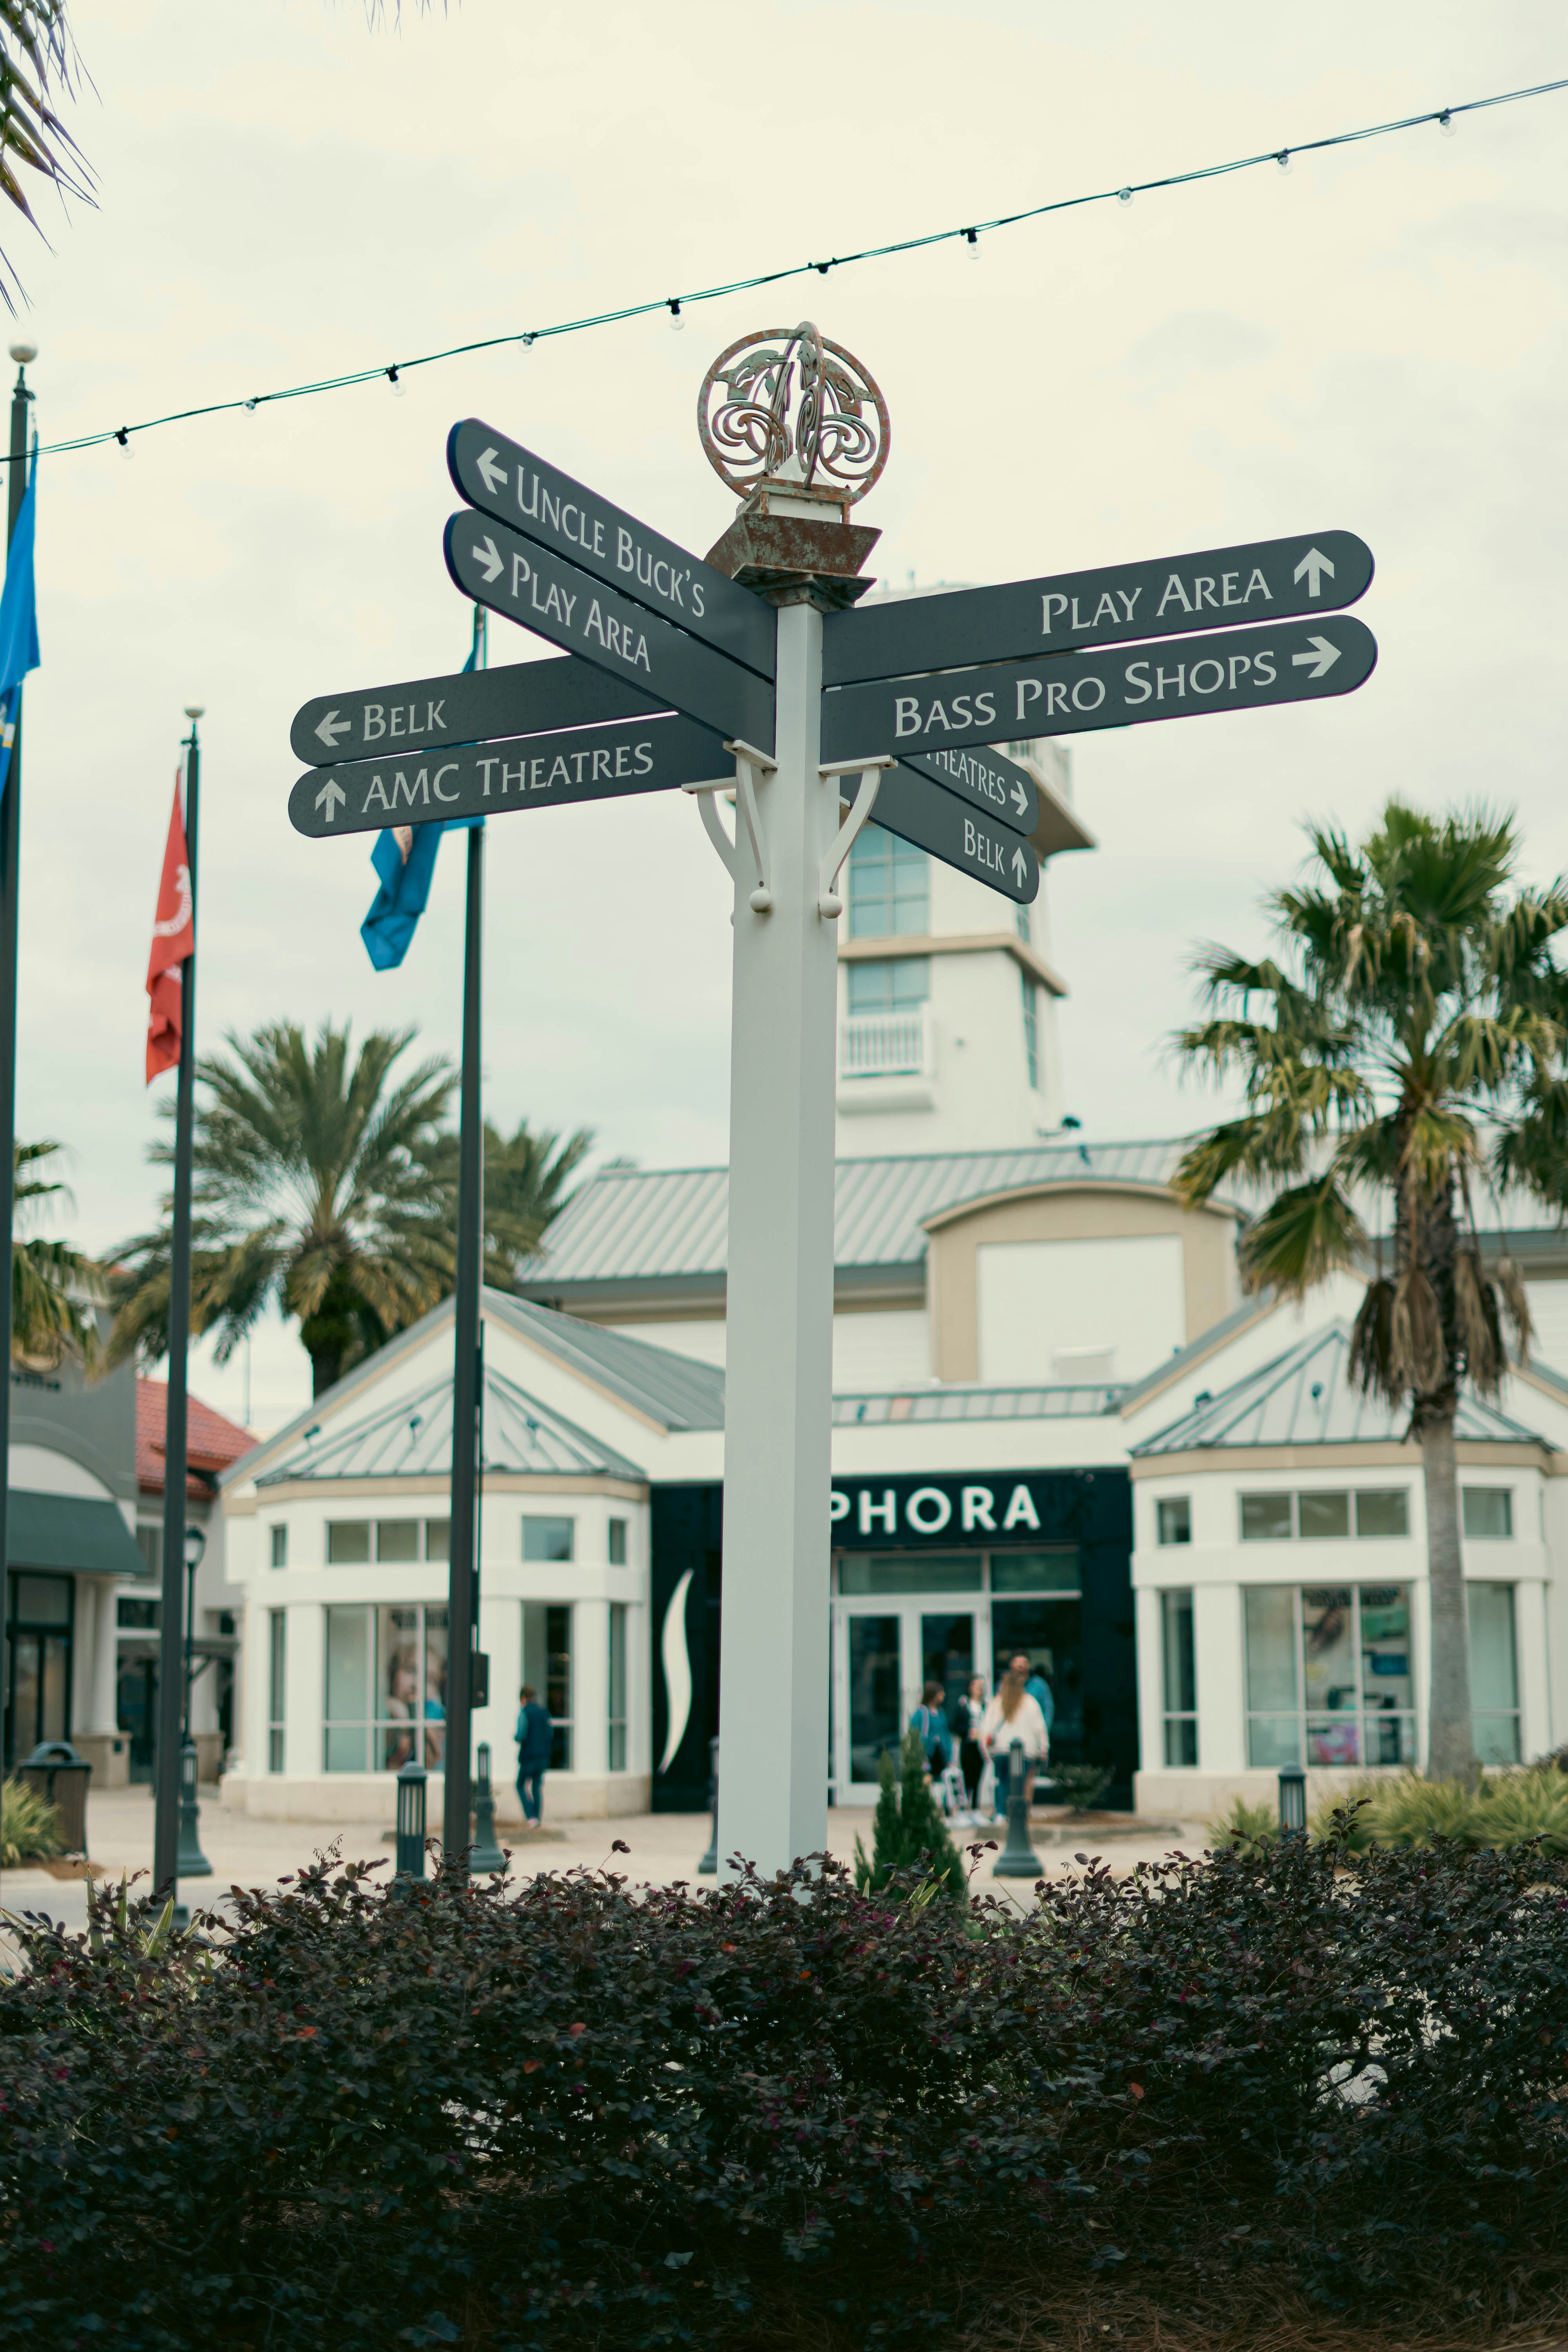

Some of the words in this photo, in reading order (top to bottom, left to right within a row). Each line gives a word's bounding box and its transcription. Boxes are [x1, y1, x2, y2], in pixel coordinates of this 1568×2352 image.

[517, 464, 606, 559] UNCLE
[616, 526, 705, 618] BUCK'S
[511, 552, 577, 627] PLAY
[583, 598, 651, 673] AREA
[1041, 587, 1143, 635] PLAY
[1156, 568, 1274, 617] AREA
[363, 699, 447, 742] BELK
[895, 692, 996, 737] BASS
[1016, 677, 1106, 720] PRO
[1124, 651, 1277, 704] SHOPS
[361, 763, 460, 813] AMC
[475, 742, 653, 797] THEATRES
[926, 750, 1006, 805] HEATRES
[964, 818, 1005, 875] BELK
